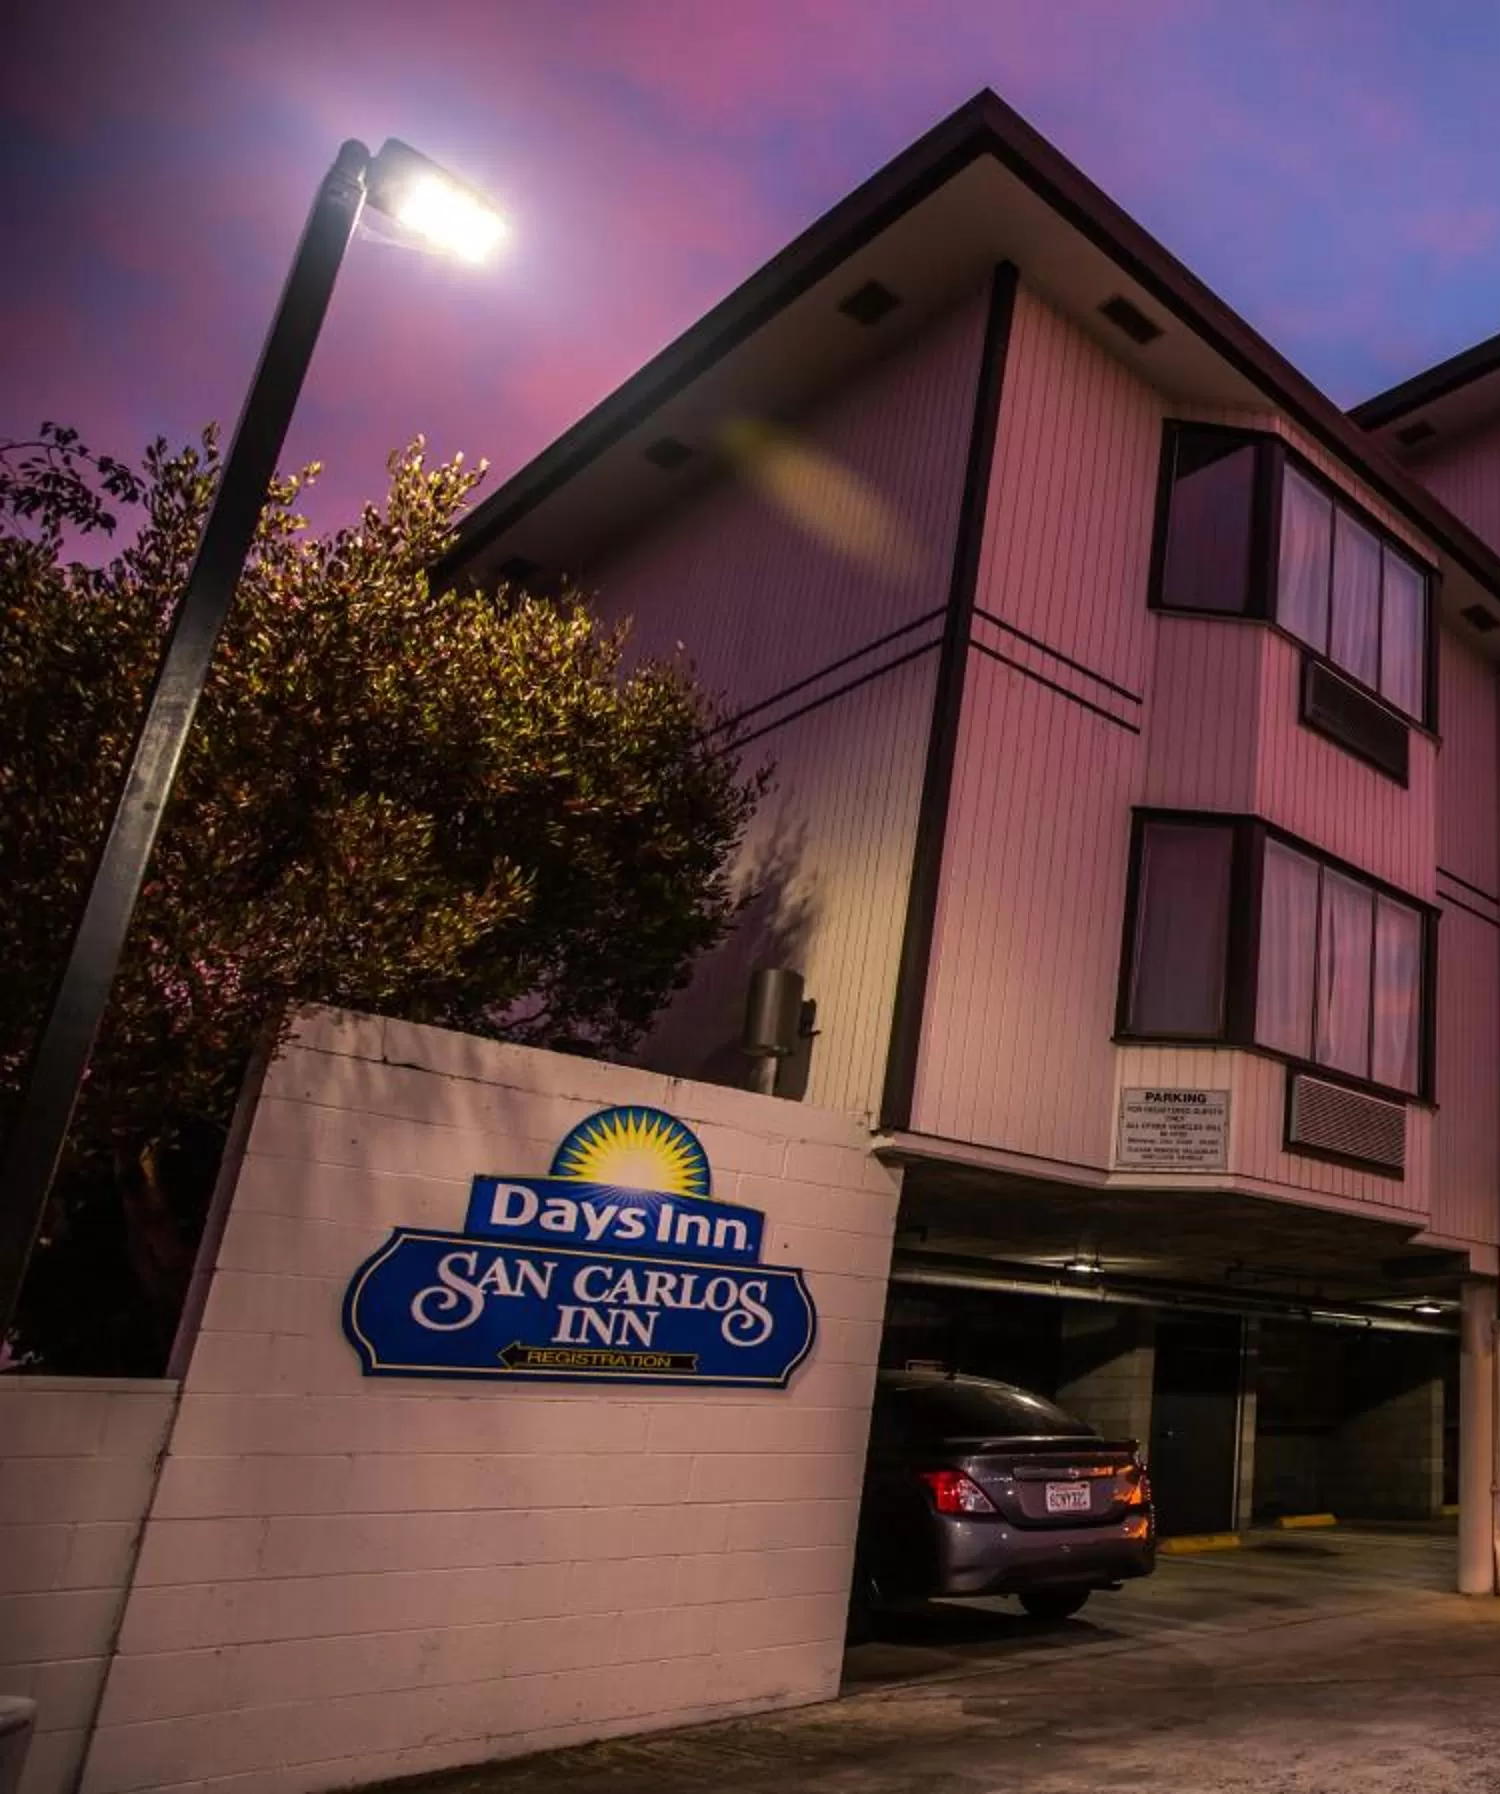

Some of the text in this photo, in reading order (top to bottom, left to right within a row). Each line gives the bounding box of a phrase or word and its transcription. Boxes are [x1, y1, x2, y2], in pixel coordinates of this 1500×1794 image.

[1145, 1092, 1207, 1103] PARKING
[489, 1183, 748, 1250] Days Inn
[411, 1251, 774, 1347] SAN CARLOS
[551, 1304, 660, 1347] INN
[527, 1350, 672, 1368] REGISTRATION
